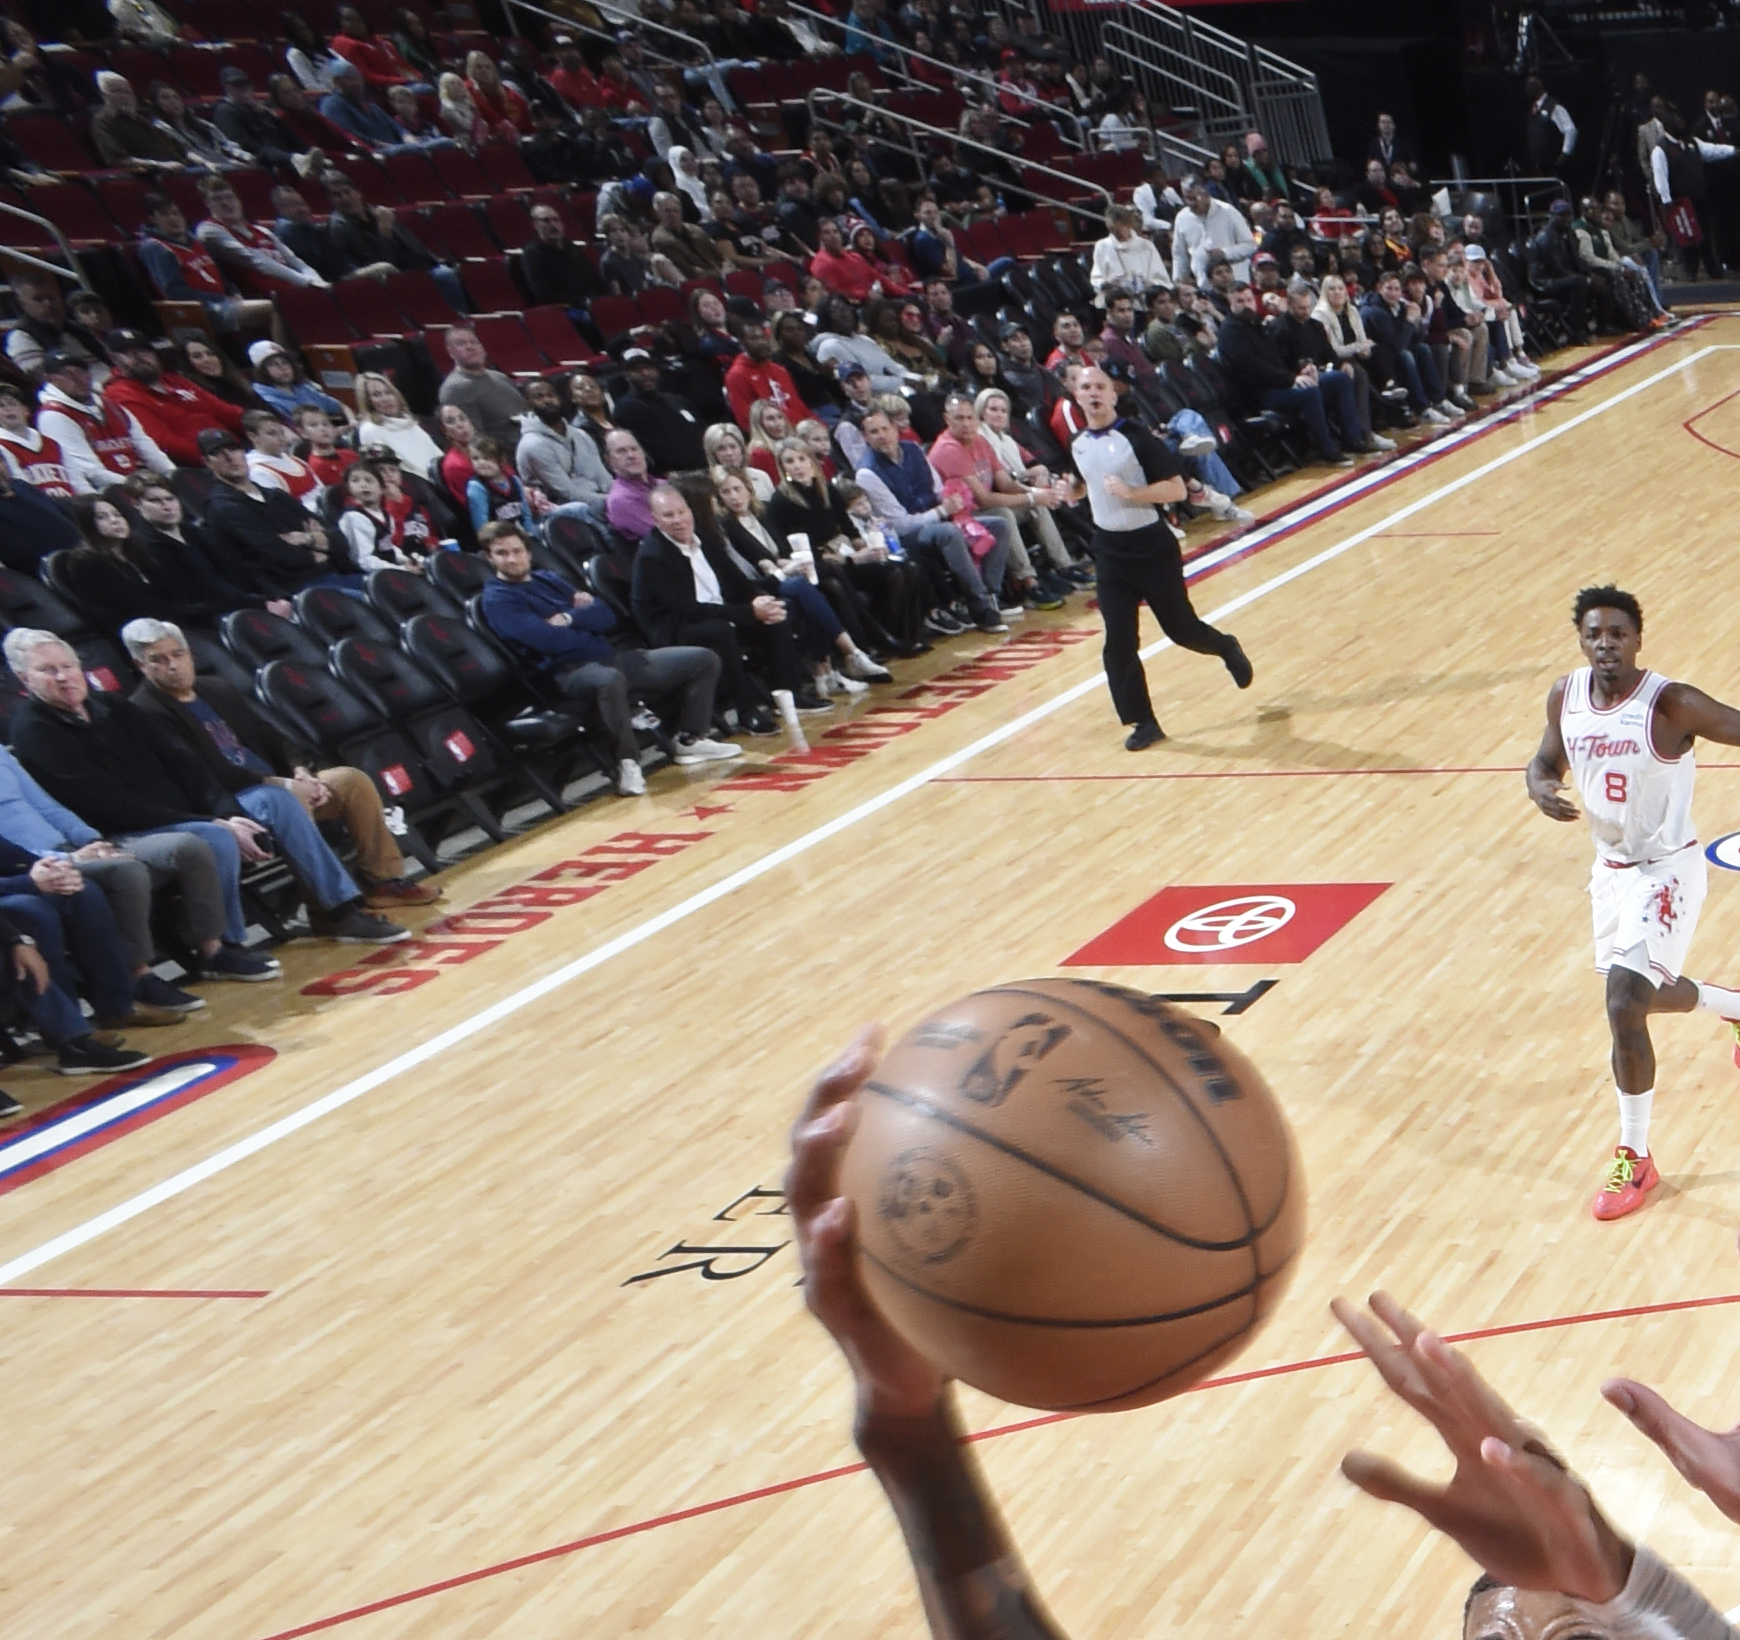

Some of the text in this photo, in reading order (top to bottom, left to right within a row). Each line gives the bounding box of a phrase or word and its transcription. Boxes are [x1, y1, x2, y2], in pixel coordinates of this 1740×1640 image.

[300, 629, 1102, 996] HOMETOWN HEROES
[1604, 770, 1628, 804] 8
